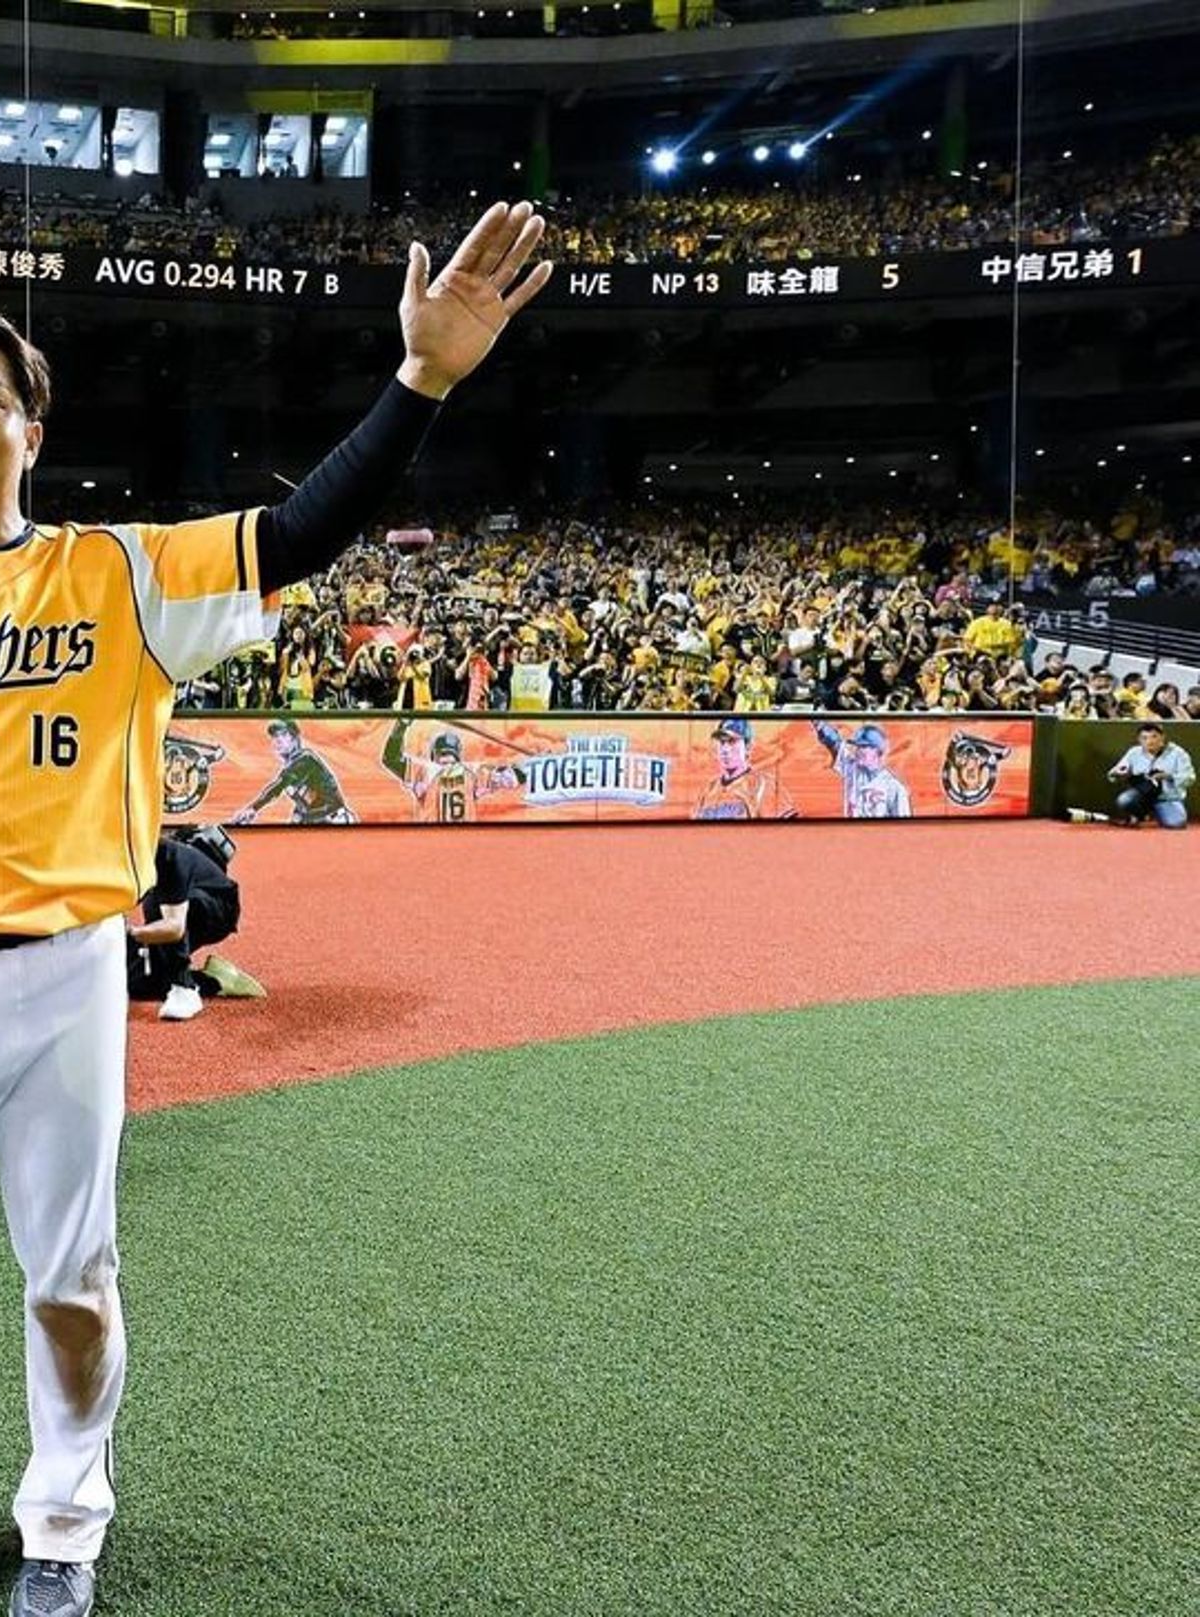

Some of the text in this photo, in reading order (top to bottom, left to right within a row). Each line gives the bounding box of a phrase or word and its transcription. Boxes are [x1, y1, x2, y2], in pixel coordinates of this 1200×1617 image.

[95, 257, 339, 295] AVG 0.294 HR 7 B
[746, 263, 899, 298] 味全龍 5
[981, 247, 1143, 284] 中信兄弟 1
[569, 272, 611, 297] H/E
[652, 272, 719, 295] NP 13
[1089, 601, 1110, 628] 5
[31, 714, 79, 768] 16
[441, 791, 465, 822] 16
